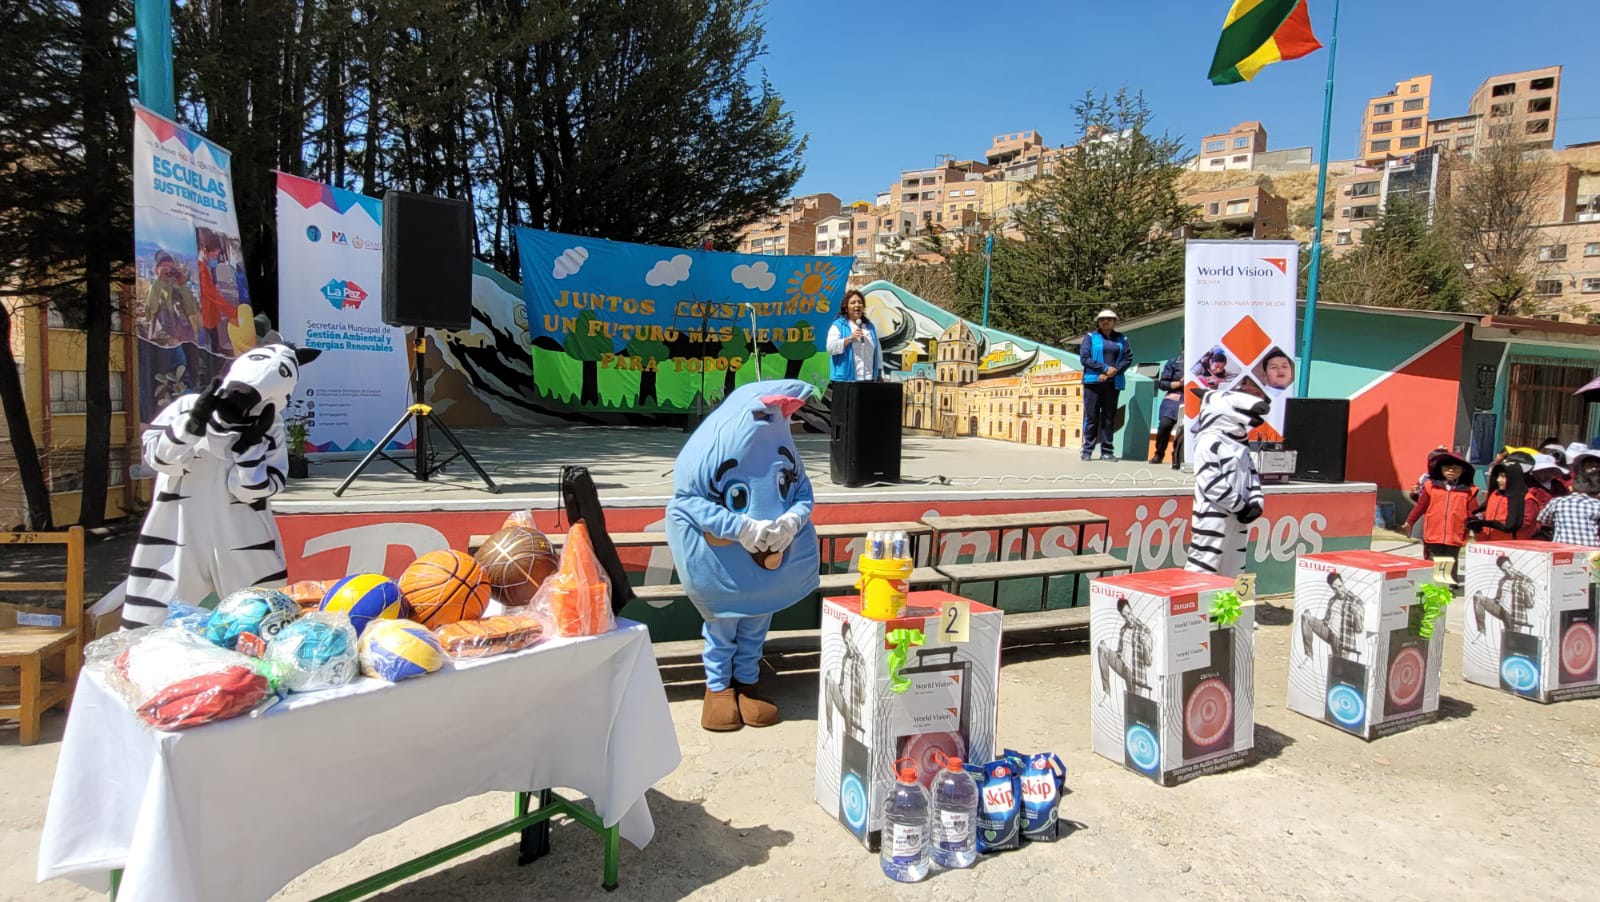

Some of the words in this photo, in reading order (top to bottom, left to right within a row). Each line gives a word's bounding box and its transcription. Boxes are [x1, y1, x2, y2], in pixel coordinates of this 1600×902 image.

[153, 155, 226, 198] ESCUELAS
[153, 178, 228, 213] SUSTENTABLES
[1197, 266, 1234, 276] World
[1238, 266, 1273, 276] Vision
[327, 286, 341, 296] La
[344, 288, 361, 298] Paz
[554, 290, 655, 315] JUNTOS
[306, 320, 346, 331] Secretaría
[348, 323, 380, 333] Municipal
[382, 326, 391, 334] de
[544, 315, 576, 333] UN
[588, 320, 679, 342] FUTURO
[688, 327, 734, 344] MAS
[744, 326, 816, 344] VERDE
[306, 330, 340, 339] Gestión
[342, 332, 384, 342] Ambiental
[386, 336, 392, 345] y
[306, 339, 344, 351] Energías
[346, 340, 393, 352] Renovables
[601, 352, 658, 372] PARA
[674, 356, 742, 372] TODOS
[1468, 546, 1506, 557] aiwa
[1298, 559, 1337, 574] aiwa
[1439, 562, 1448, 576] 4
[1092, 585, 1126, 600] aiwa
[1237, 578, 1249, 597] 3
[823, 603, 848, 622] aiwa
[1173, 601, 1196, 611] aiwa
[945, 606, 959, 634] 2
[915, 681, 934, 689] World
[935, 680, 953, 688] Vision
[1022, 777, 1051, 799] skip
[986, 785, 1013, 808] skip
